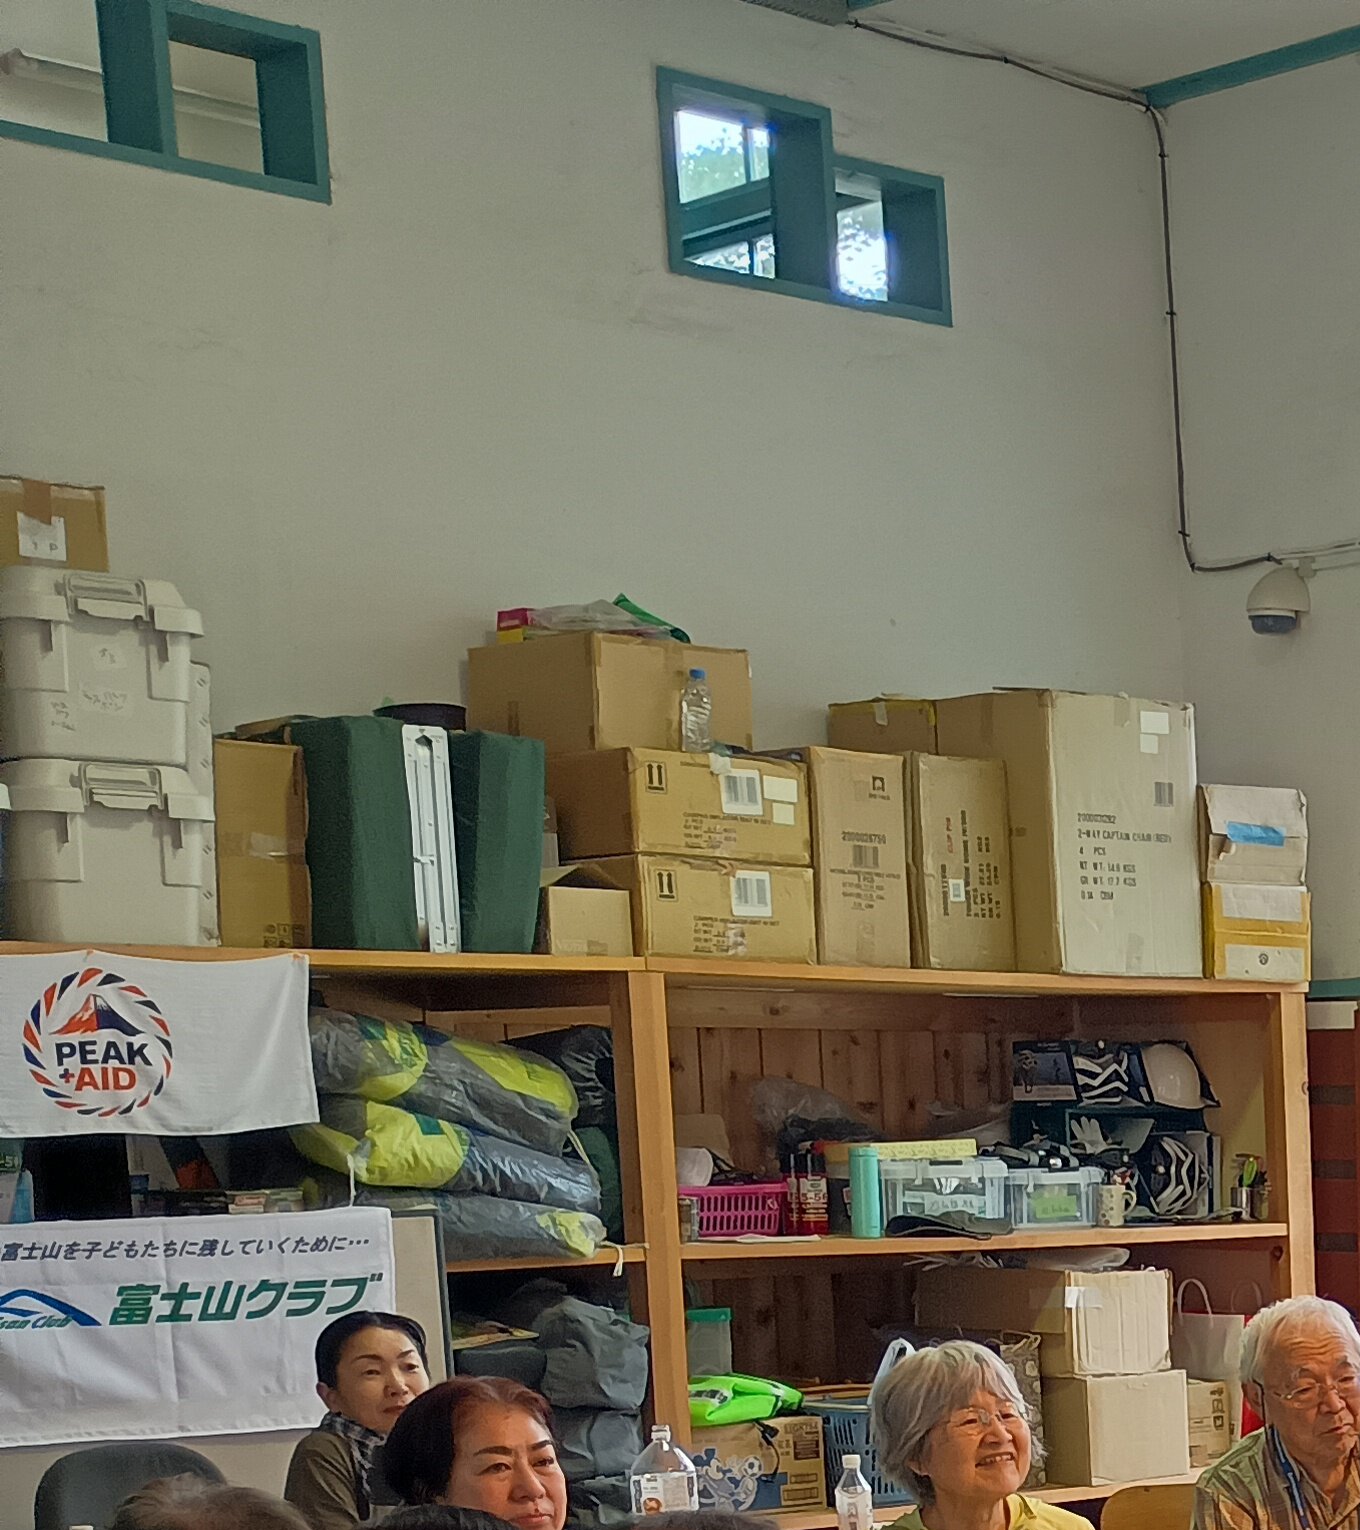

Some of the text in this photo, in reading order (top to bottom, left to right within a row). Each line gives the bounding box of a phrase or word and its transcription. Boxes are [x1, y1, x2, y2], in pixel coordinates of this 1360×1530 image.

[55, 1040, 153, 1066] PEAK
[109, 1272, 384, 1326] 富士山クラブ
